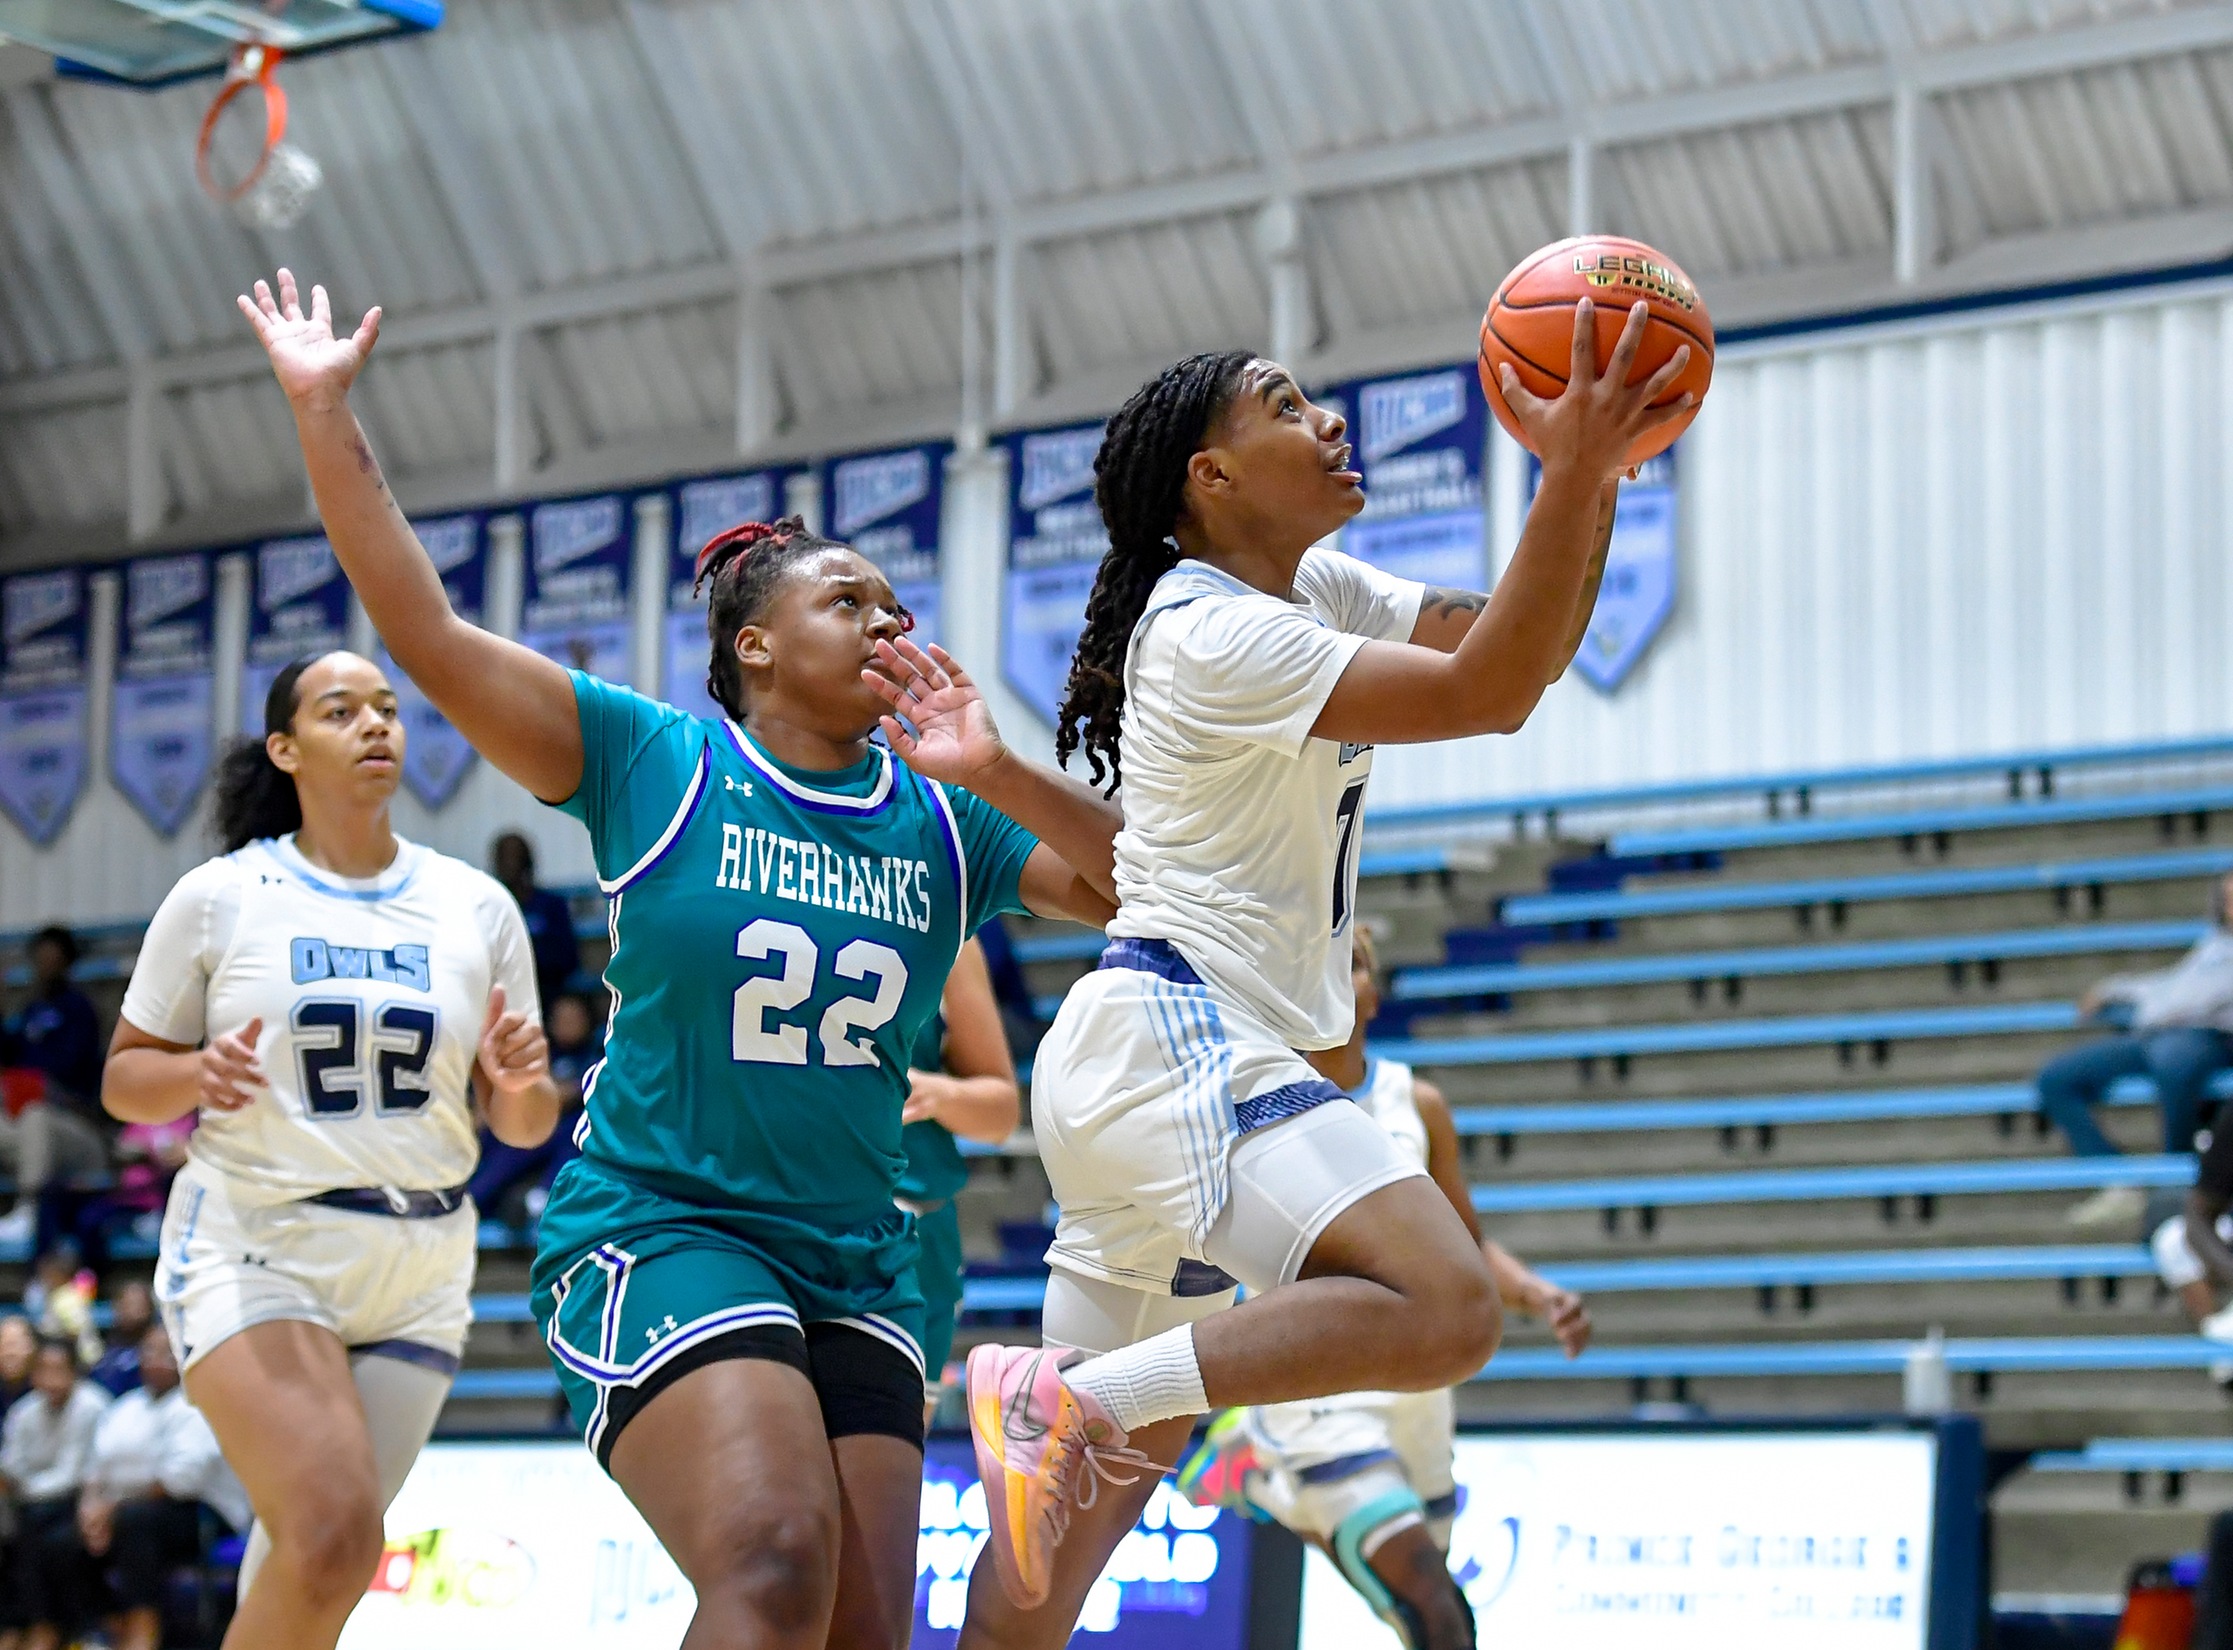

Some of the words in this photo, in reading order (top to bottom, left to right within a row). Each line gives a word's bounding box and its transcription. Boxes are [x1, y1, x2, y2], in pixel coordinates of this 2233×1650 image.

[715, 822, 931, 934] RIVERHAWKS
[289, 937, 431, 993] OWLS
[732, 917, 910, 1069] 22
[289, 995, 441, 1121] 22
